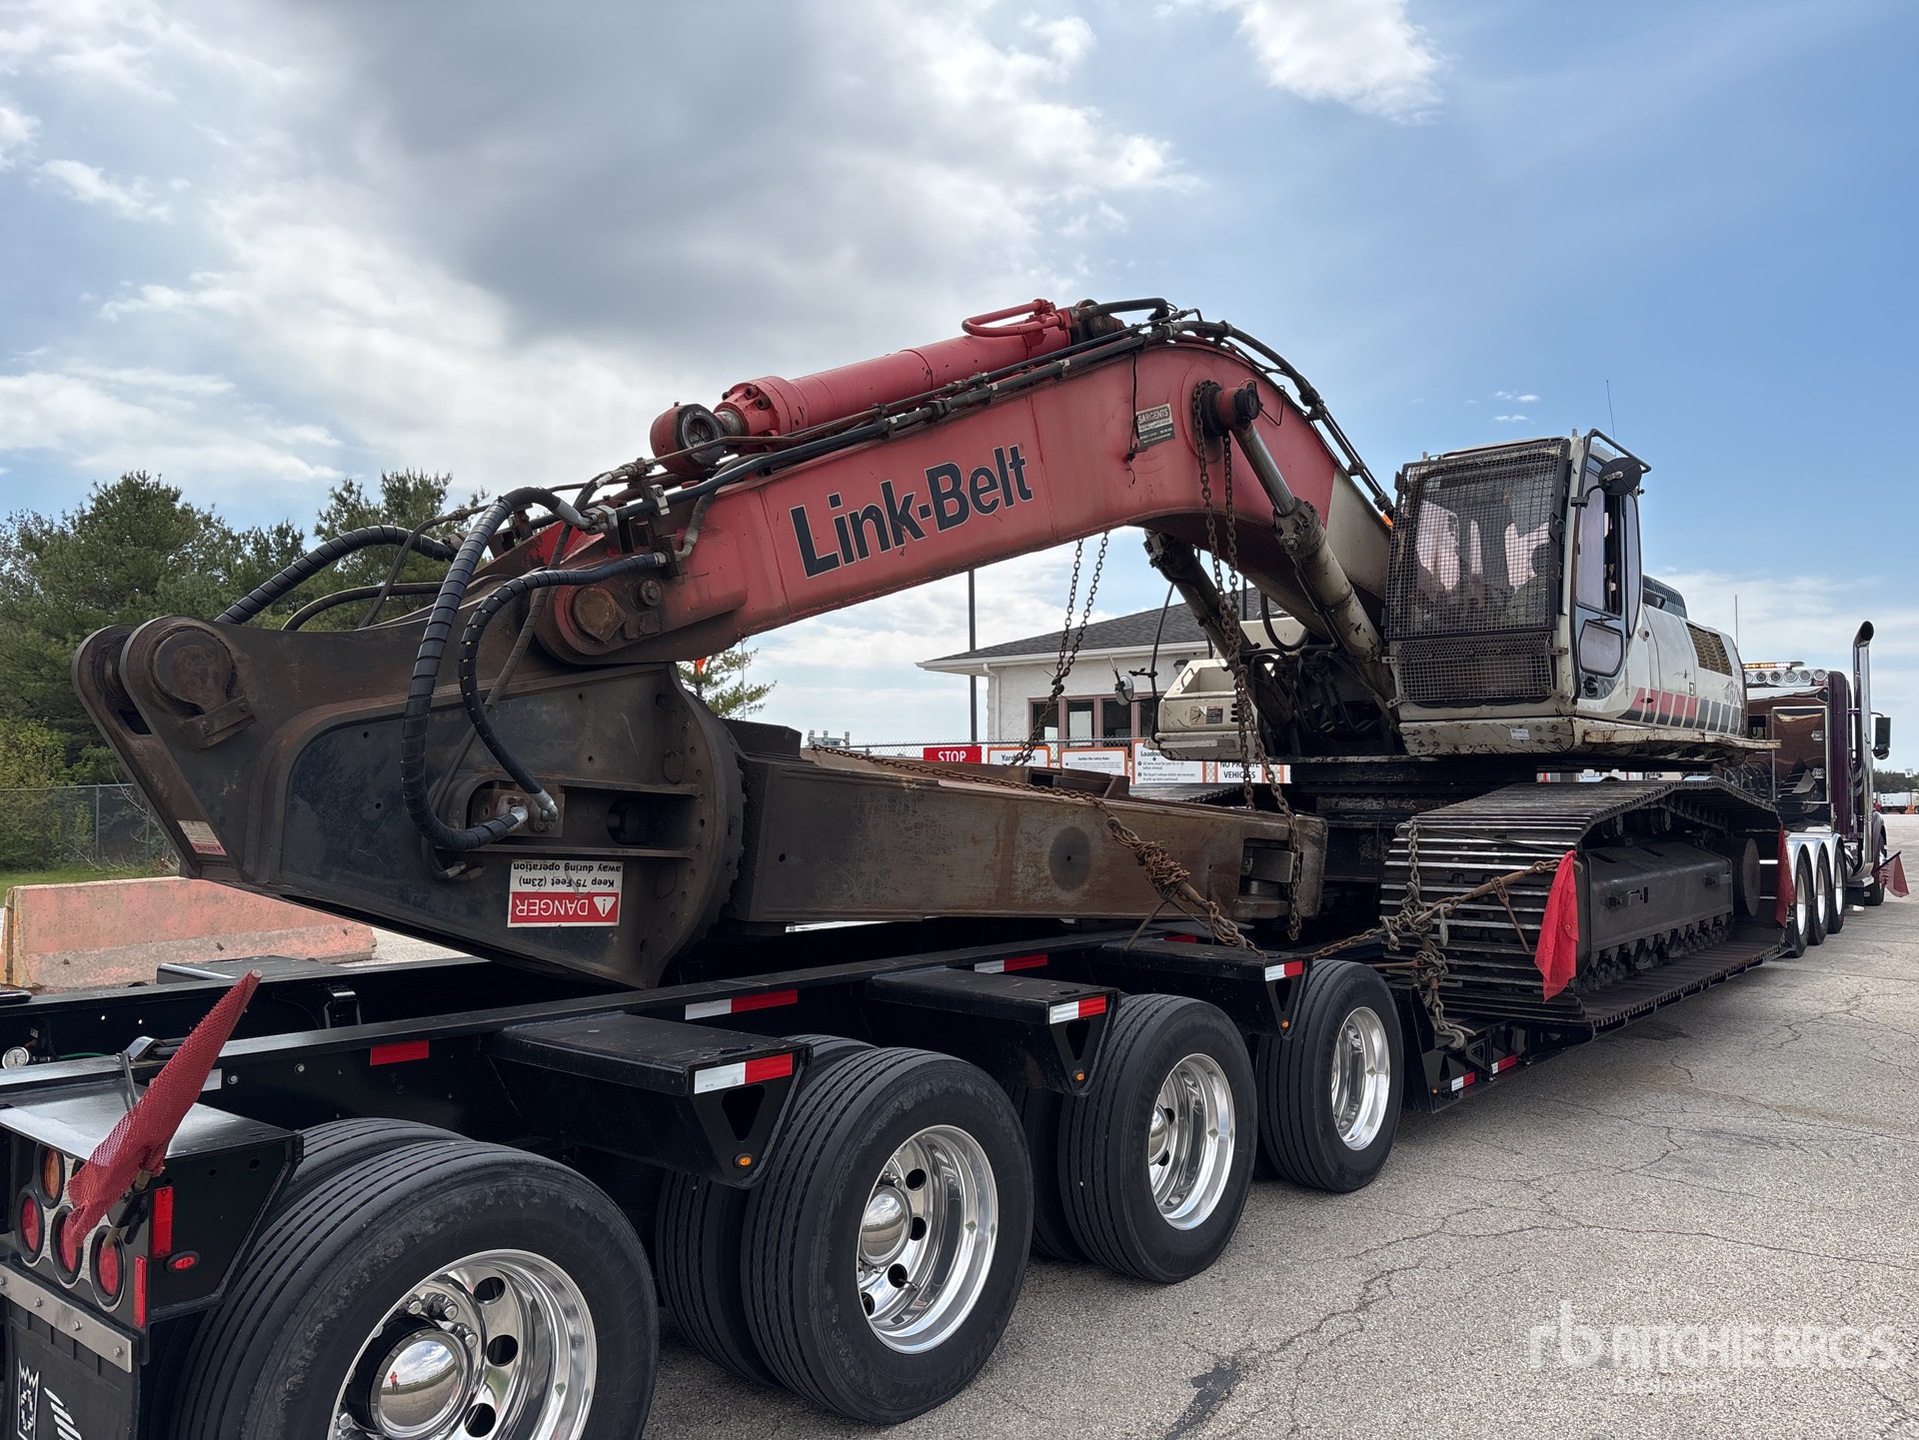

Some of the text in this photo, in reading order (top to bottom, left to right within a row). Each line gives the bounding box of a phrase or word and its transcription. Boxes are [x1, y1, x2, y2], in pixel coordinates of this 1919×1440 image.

[789, 444, 1034, 579] Link-Belt
[938, 750, 967, 762] STOP
[513, 862, 621, 873] away during operation
[518, 875, 614, 888] Keep 75 Feet (23m)
[515, 899, 589, 916] DANGER
